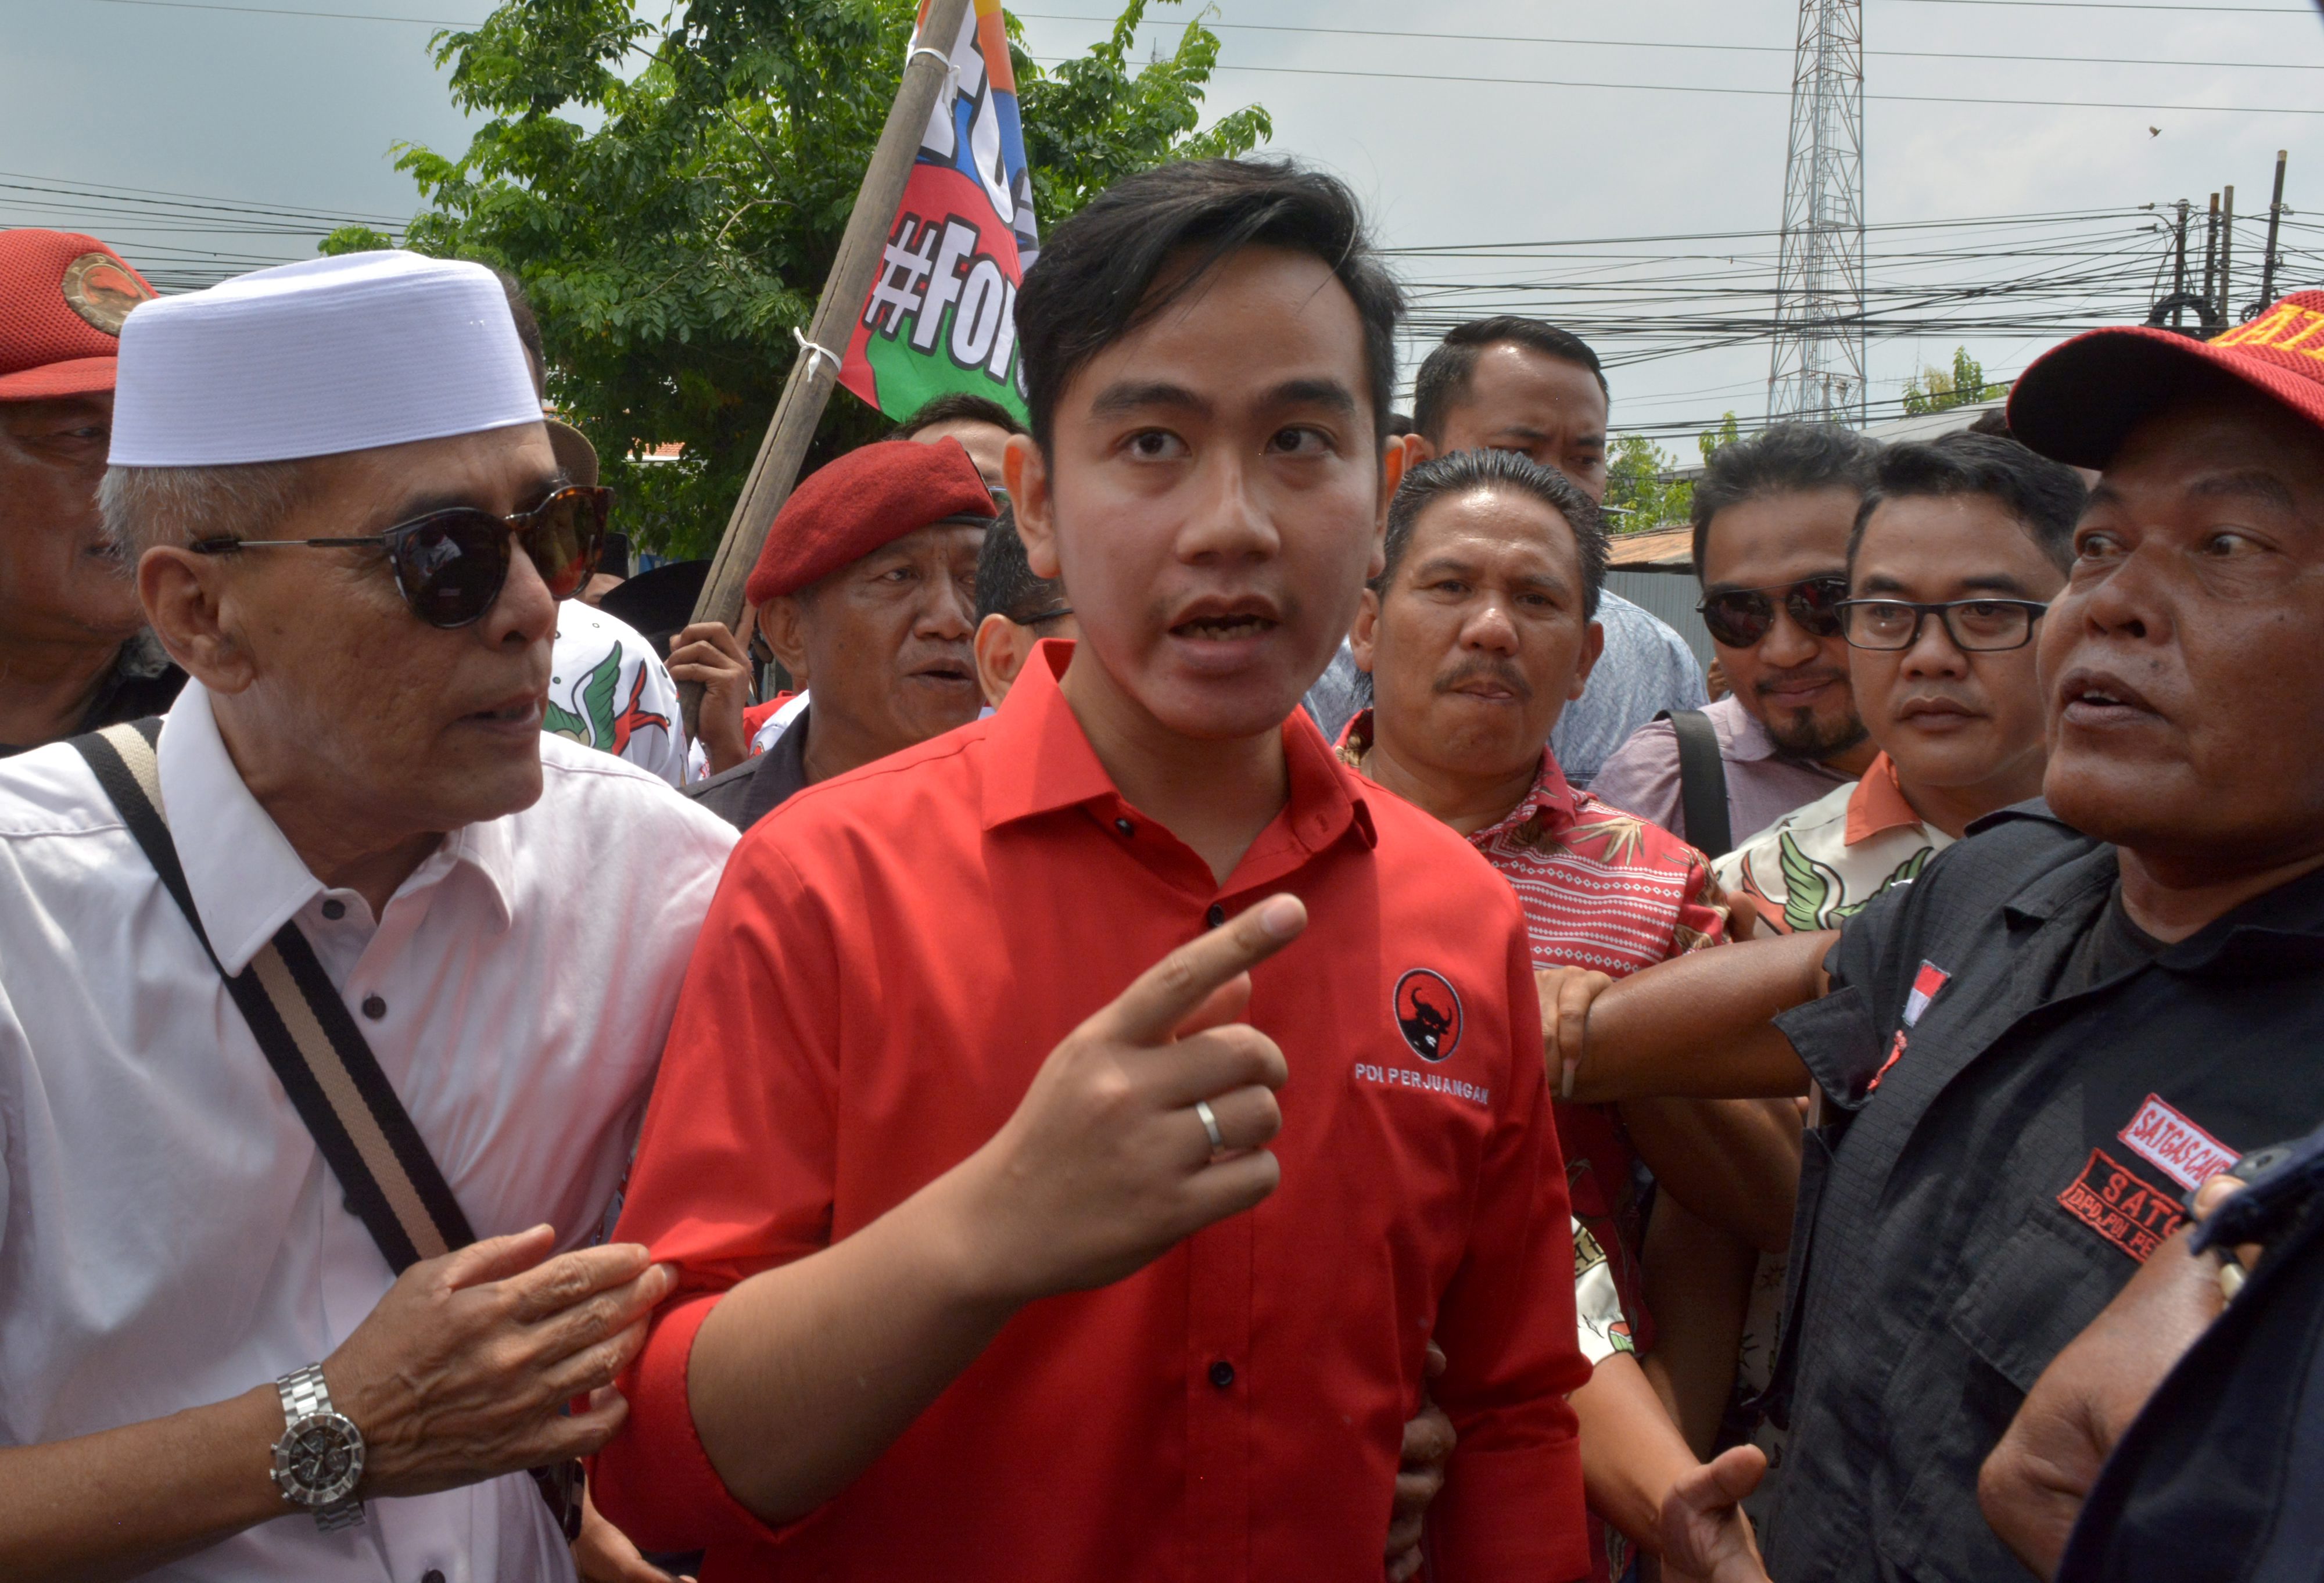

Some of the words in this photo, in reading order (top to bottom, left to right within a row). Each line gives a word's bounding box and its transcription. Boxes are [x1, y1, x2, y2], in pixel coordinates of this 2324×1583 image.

[1355, 1063, 1385, 1083] PDI
[1389, 1068, 1489, 1105] PERJUANGAN
[2135, 1110, 2200, 1165] SATGAS
